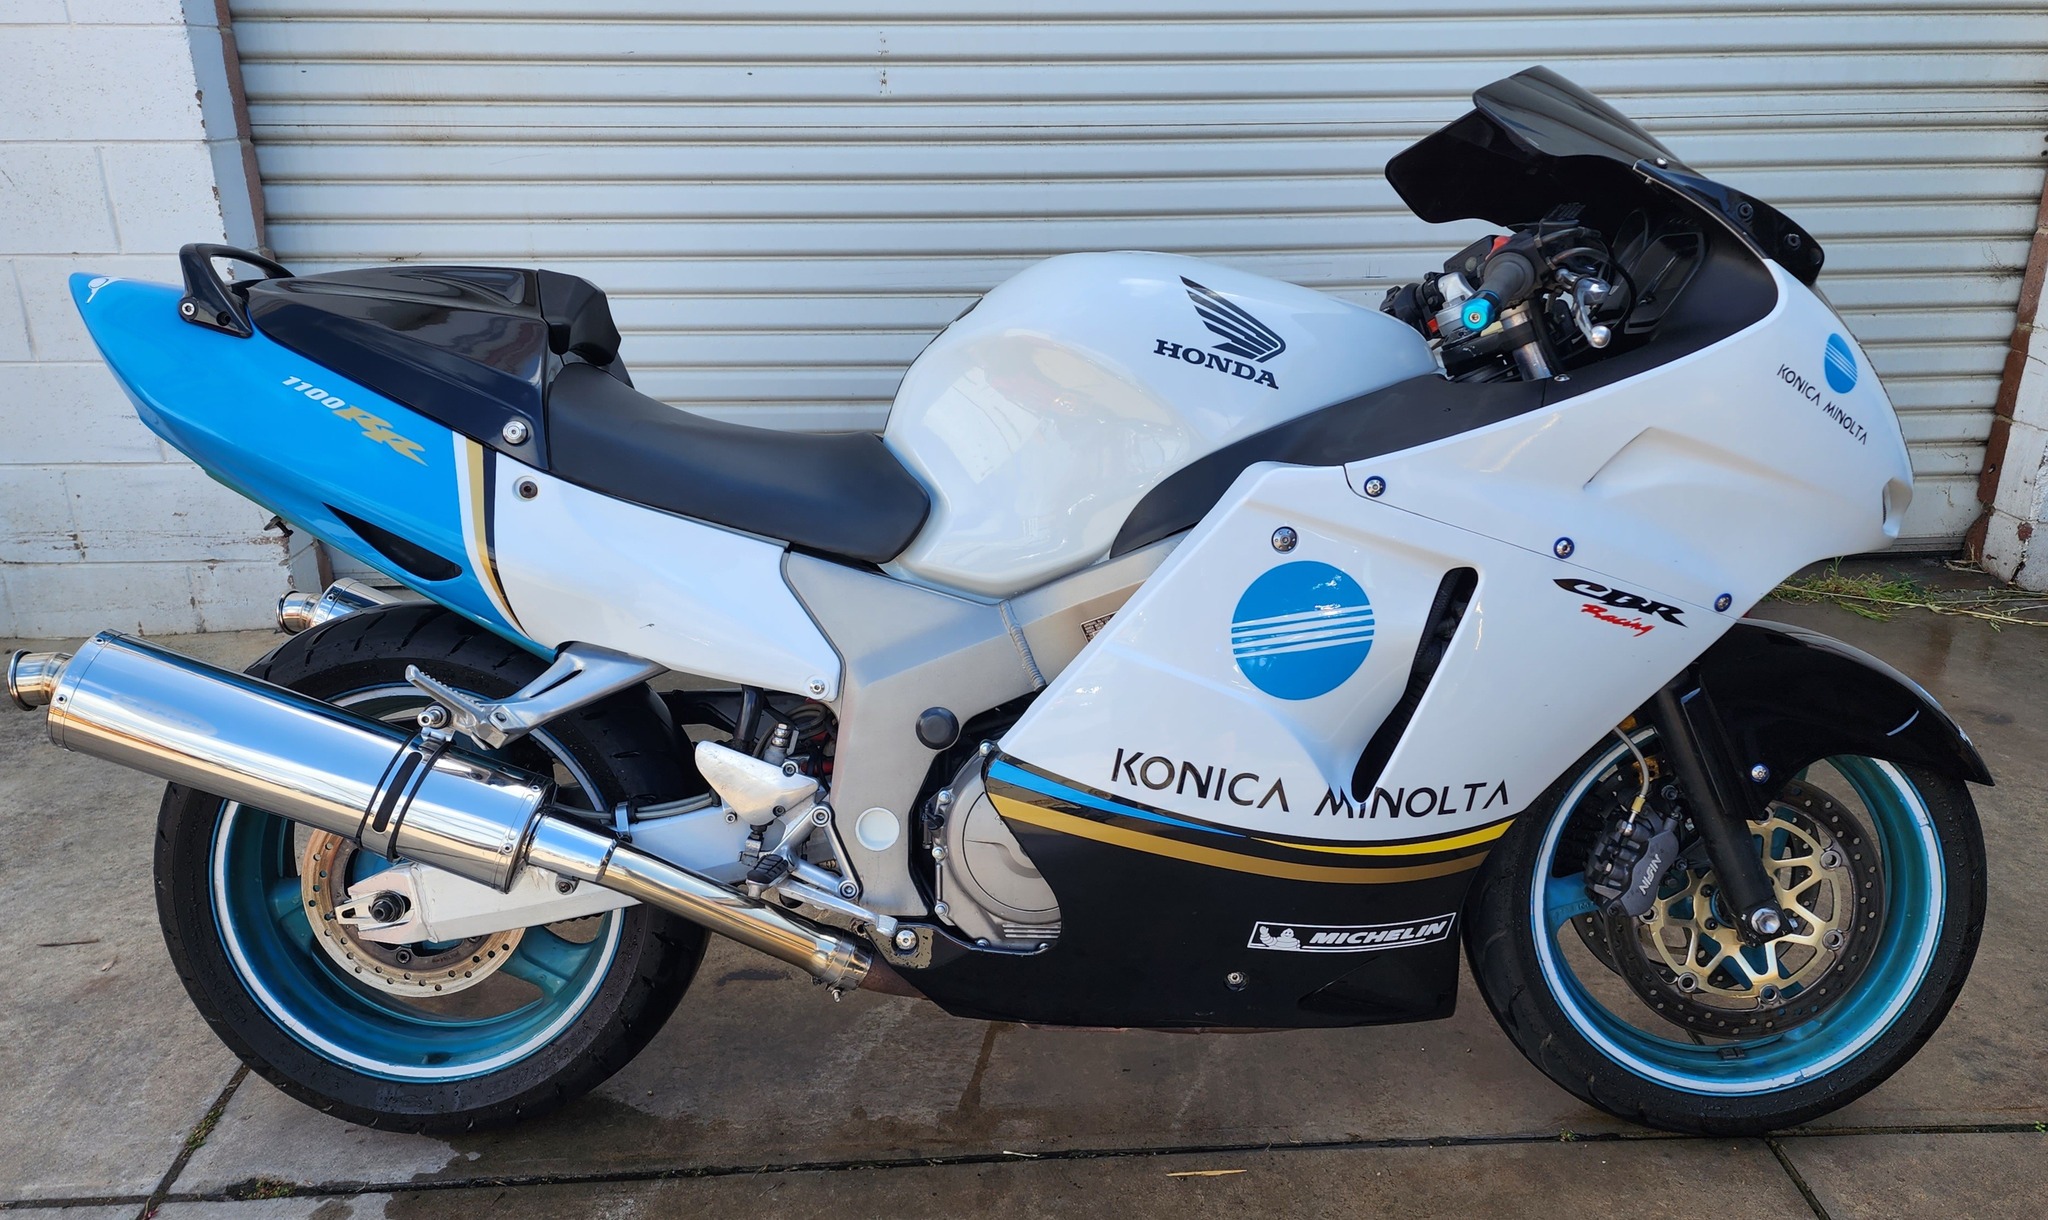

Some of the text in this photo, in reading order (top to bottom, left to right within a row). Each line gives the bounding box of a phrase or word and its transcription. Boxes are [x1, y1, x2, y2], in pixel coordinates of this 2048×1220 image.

[1153, 339, 1279, 390] HONDA
[1777, 364, 1868, 445] KONICA MINOLTA
[1552, 578, 1689, 629] CBR
[1581, 603, 1656, 638] Racing
[1111, 747, 1290, 813] KONICA
[1309, 920, 1448, 945] MICHELIN
